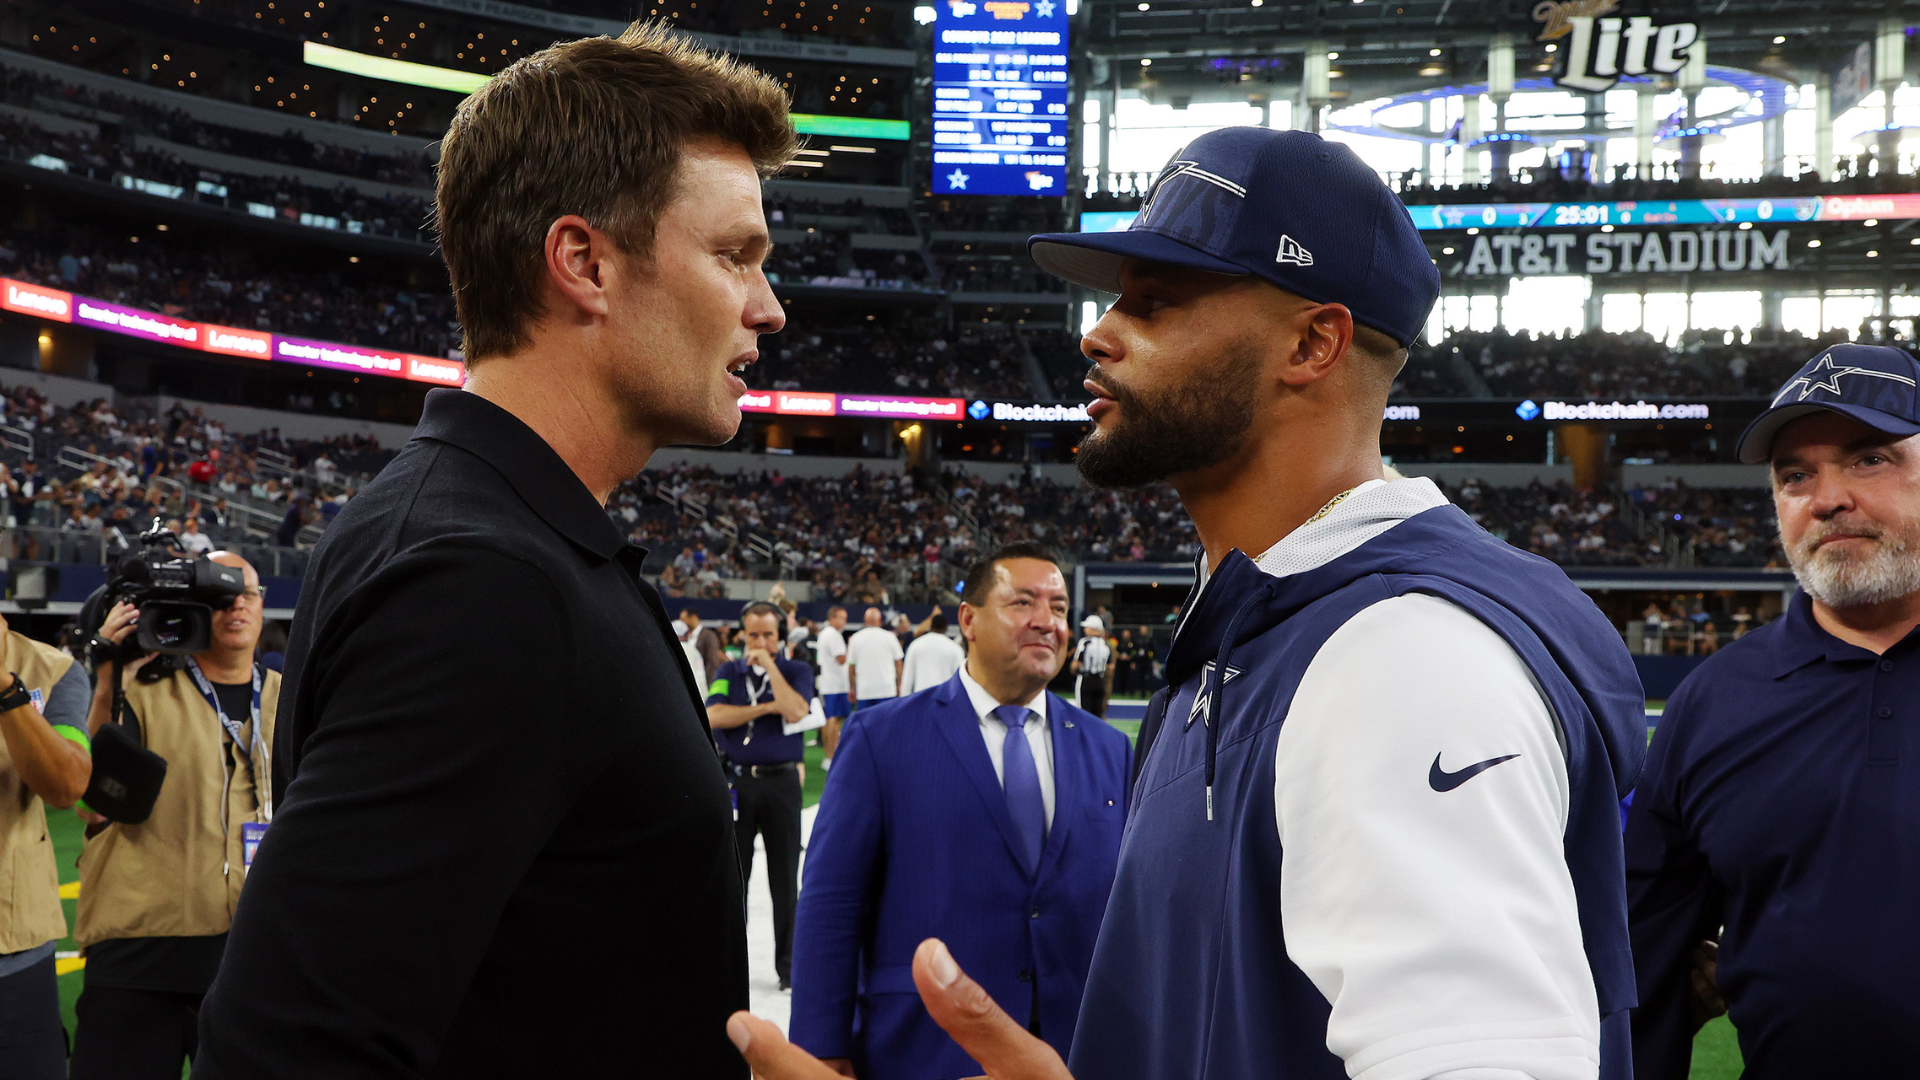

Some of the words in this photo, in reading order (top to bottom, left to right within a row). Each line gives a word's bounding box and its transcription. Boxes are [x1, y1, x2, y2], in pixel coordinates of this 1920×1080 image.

[1557, 16, 1697, 92] Lite
[1482, 206, 1497, 226] 0
[1555, 205, 1609, 226] 25:01
[1757, 200, 1773, 219] 0
[1826, 197, 1895, 219] Optum
[1465, 233, 1577, 275] AT&T
[1586, 228, 1791, 274] STADIUM
[9, 286, 67, 315] Lenovo
[78, 302, 119, 325] Smarter
[119, 312, 170, 338] technology
[170, 323, 184, 338] for
[184, 327, 197, 342] all
[208, 329, 267, 354] Lenovo
[278, 341, 320, 359] Smarter
[320, 347, 374, 369] technology
[374, 354, 388, 368] for
[388, 357, 401, 371] all
[410, 359, 460, 381] Lenovo
[780, 395, 832, 411] Lenovo
[841, 398, 879, 411] Smarter
[879, 400, 930, 415] technology
[930, 402, 944, 414] for
[944, 403, 957, 415] all
[1543, 400, 1709, 420] Blockchain.com
